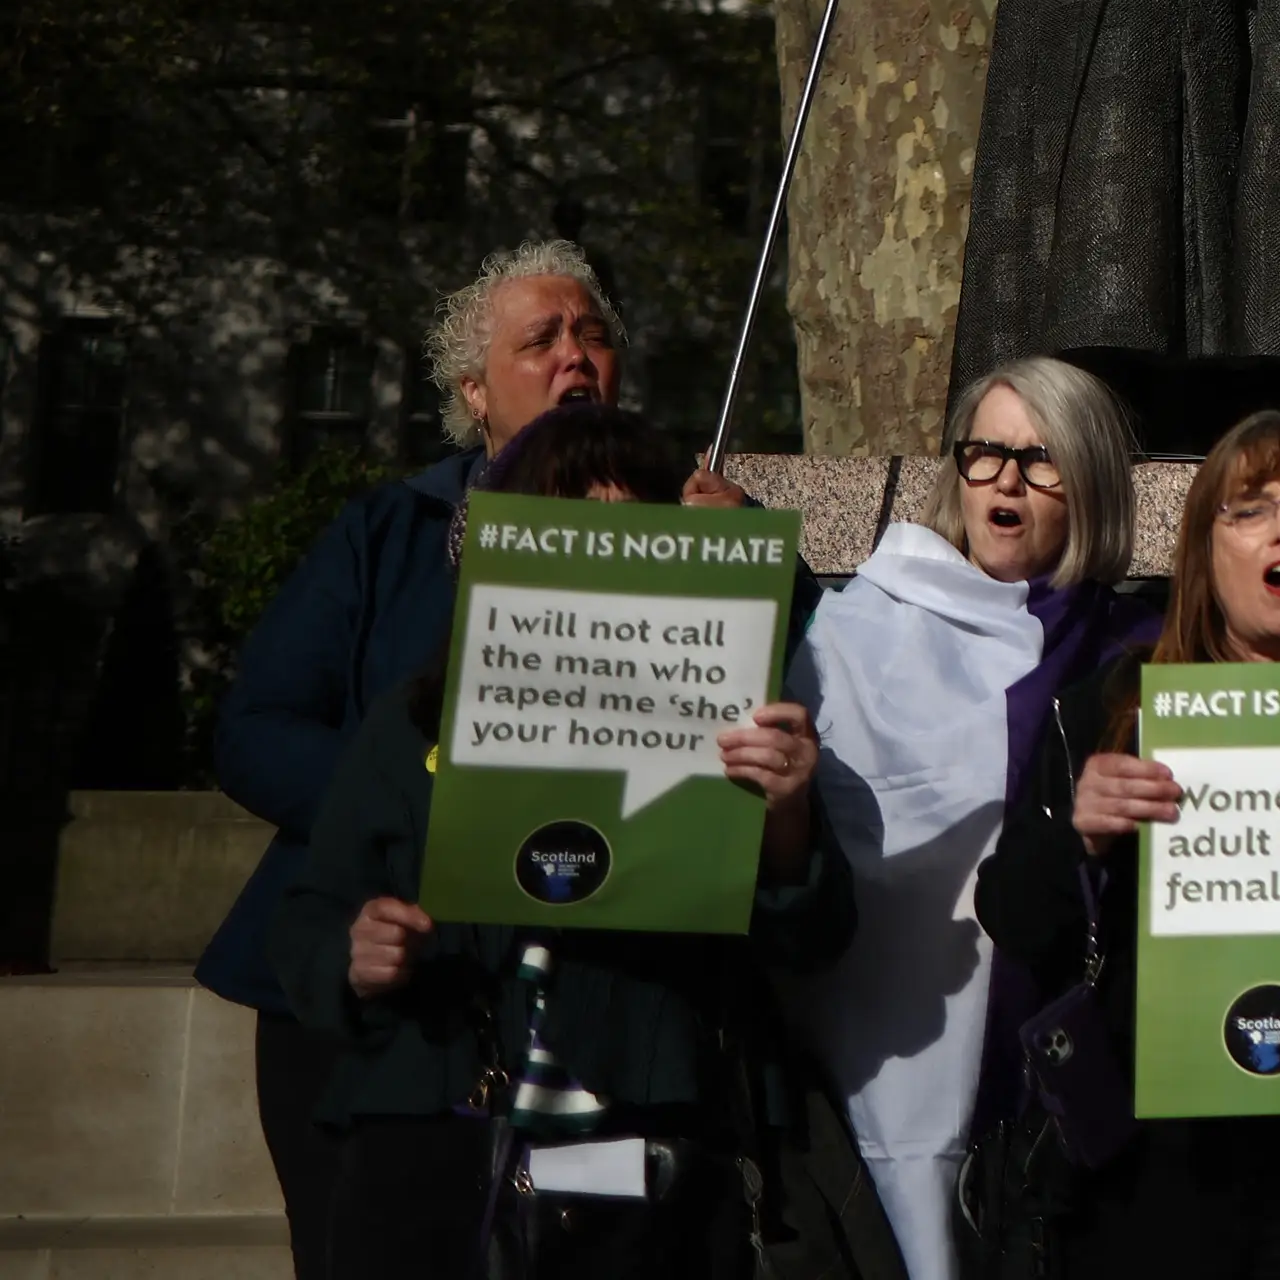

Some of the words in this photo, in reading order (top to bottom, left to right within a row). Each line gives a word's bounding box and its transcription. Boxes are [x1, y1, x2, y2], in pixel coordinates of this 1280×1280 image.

[479, 523, 579, 556] #FACT
[585, 532, 614, 557] IS
[623, 534, 695, 561] NOT
[702, 536, 784, 564] HATE
[488, 606, 497, 631] I
[511, 608, 577, 639] will
[590, 618, 651, 644] not
[663, 620, 725, 647] call
[482, 645, 542, 671] the
[554, 653, 638, 679] man
[650, 657, 727, 685] who
[478, 680, 587, 710] raped
[600, 690, 655, 713] me
[1153, 690, 1247, 718] #FACT
[1253, 690, 1280, 716] IS
[471, 720, 557, 748] your
[568, 718, 705, 751] honour
[531, 850, 596, 863] Scotland
[1168, 827, 1271, 857] adult
